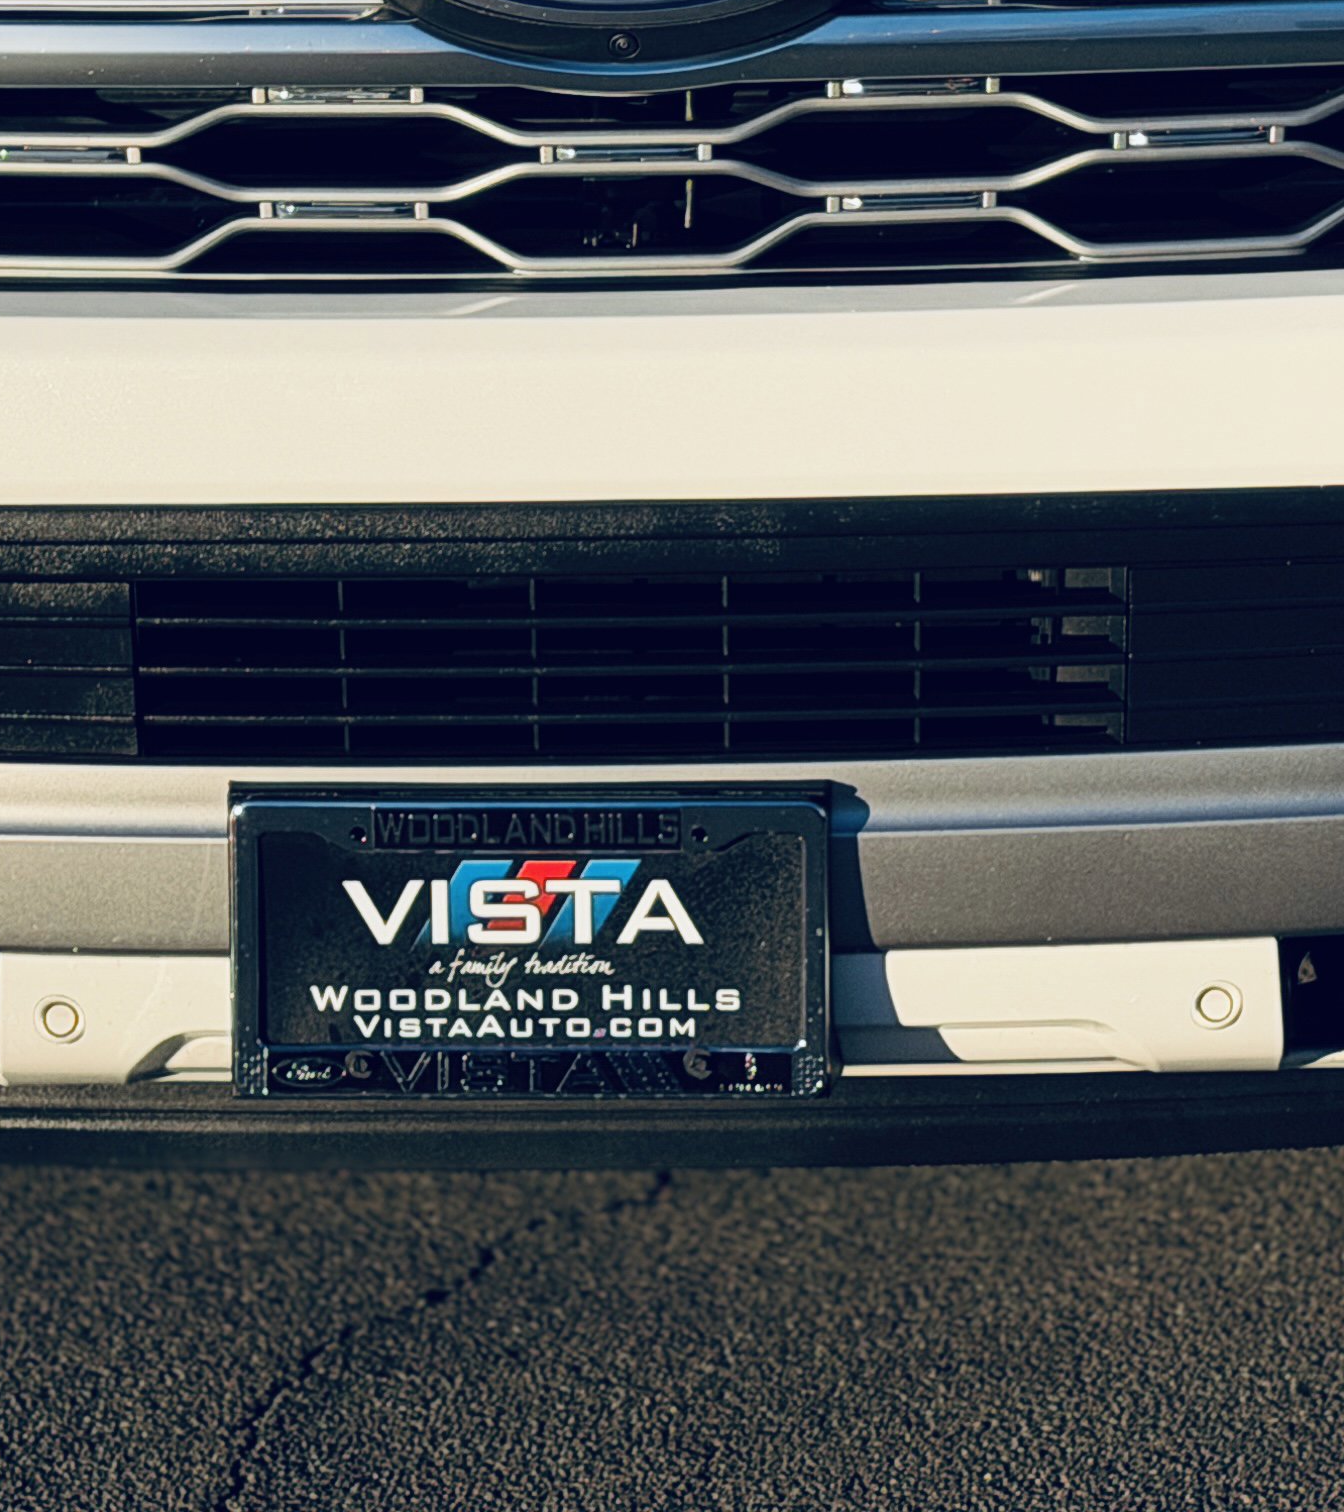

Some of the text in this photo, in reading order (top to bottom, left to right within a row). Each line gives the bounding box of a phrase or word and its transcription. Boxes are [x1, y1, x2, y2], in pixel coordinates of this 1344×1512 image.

[377, 812, 680, 845] WOODLAND HILLS
[342, 878, 704, 945] VISTA
[428, 947, 616, 988] a family tradition
[309, 984, 741, 1013] WOODLAND HILLS
